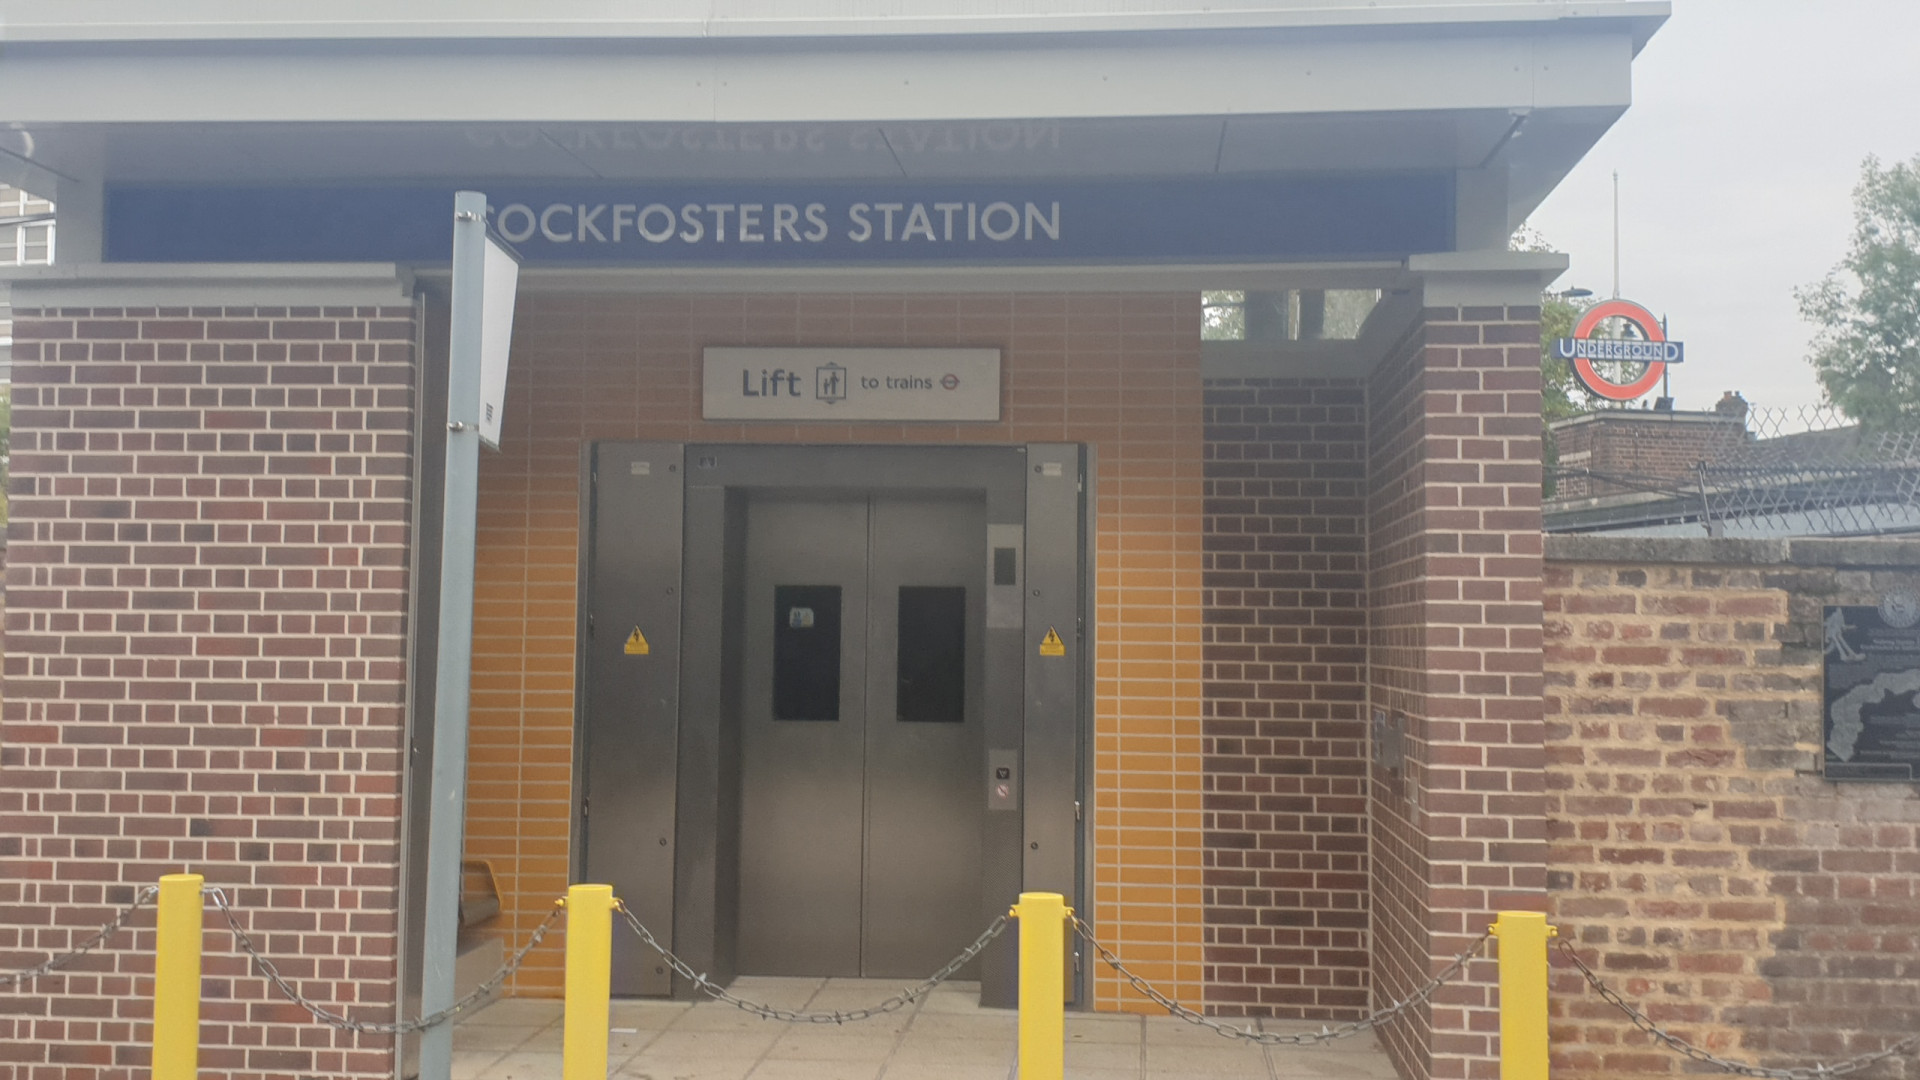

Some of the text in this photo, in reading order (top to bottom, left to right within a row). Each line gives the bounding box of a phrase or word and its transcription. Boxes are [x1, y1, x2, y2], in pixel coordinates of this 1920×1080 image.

[486, 201, 1060, 243] OCKFOSTERS STATION
[1560, 338, 1679, 361] UNDERGROUND
[742, 368, 933, 397] Lift to trains
